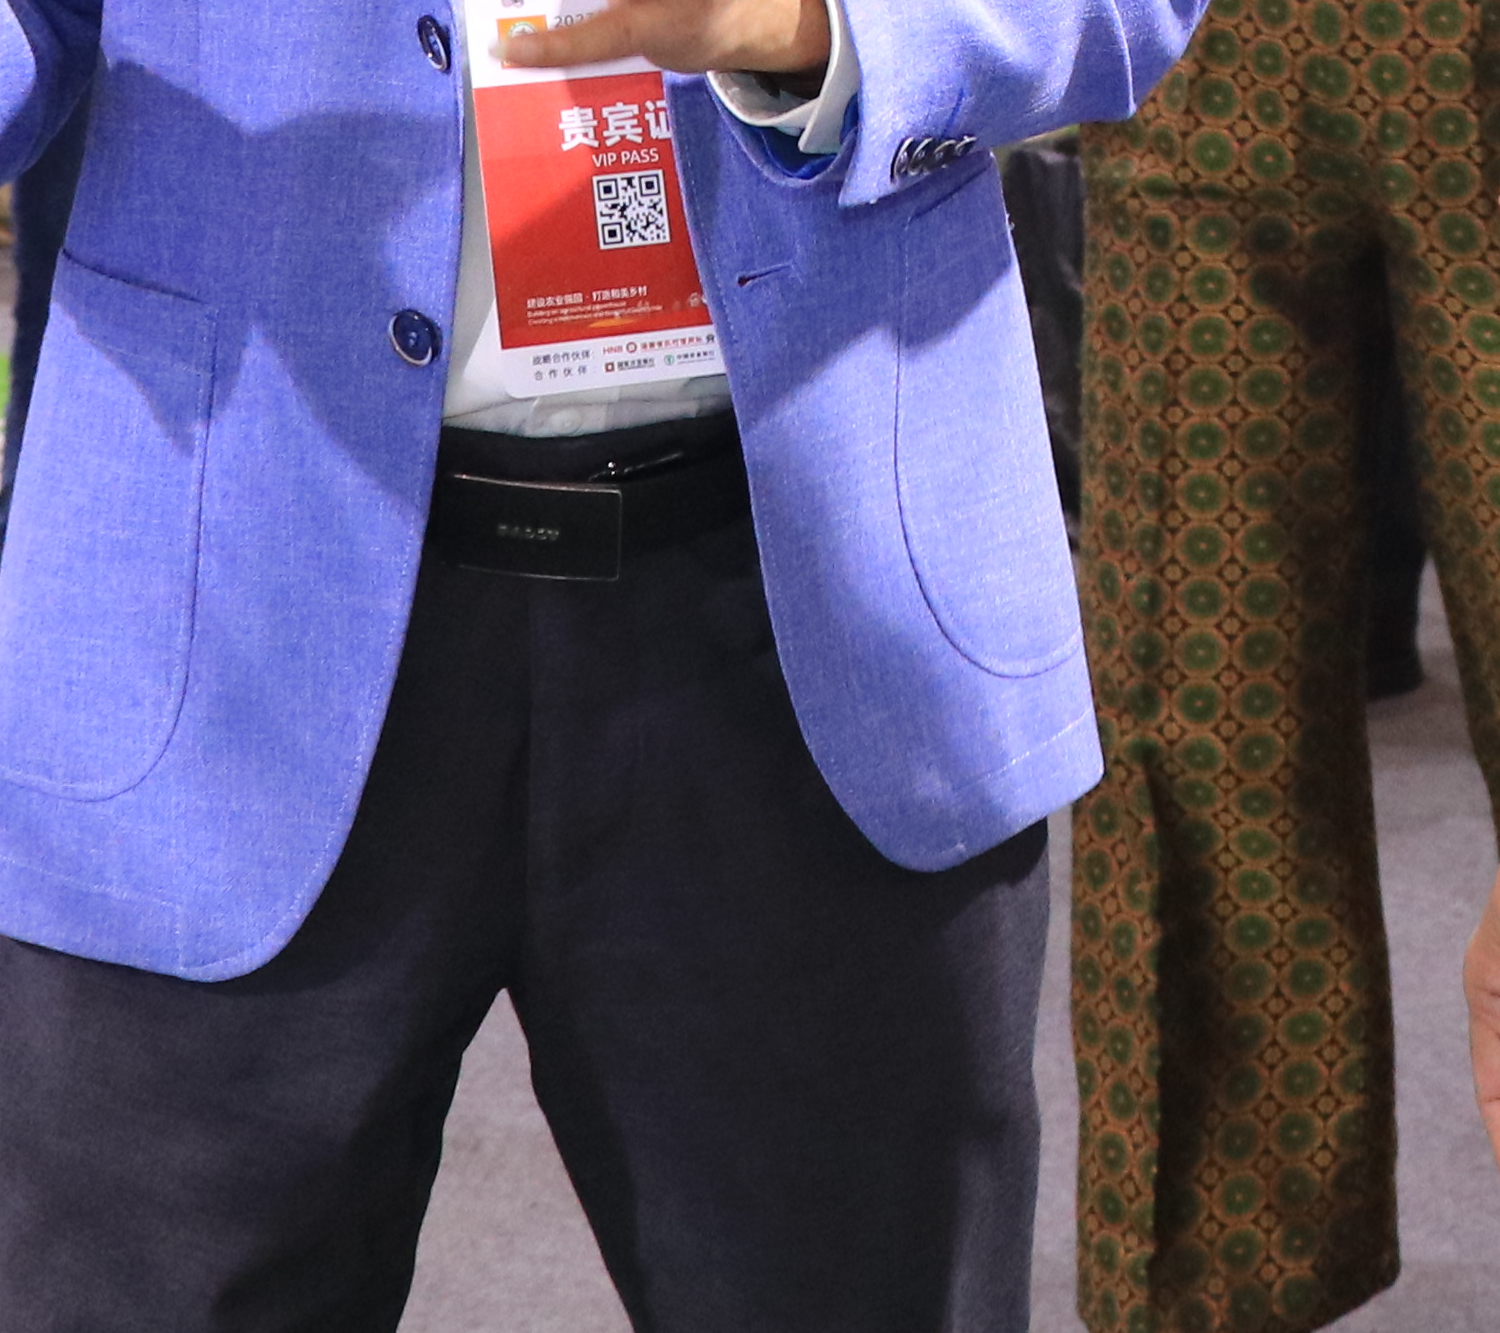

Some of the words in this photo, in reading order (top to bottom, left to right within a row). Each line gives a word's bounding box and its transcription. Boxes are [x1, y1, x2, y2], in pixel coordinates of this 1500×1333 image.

[558, 98, 672, 151] 贵宾证
[592, 151, 617, 168] VIP
[621, 148, 660, 165] PASS
